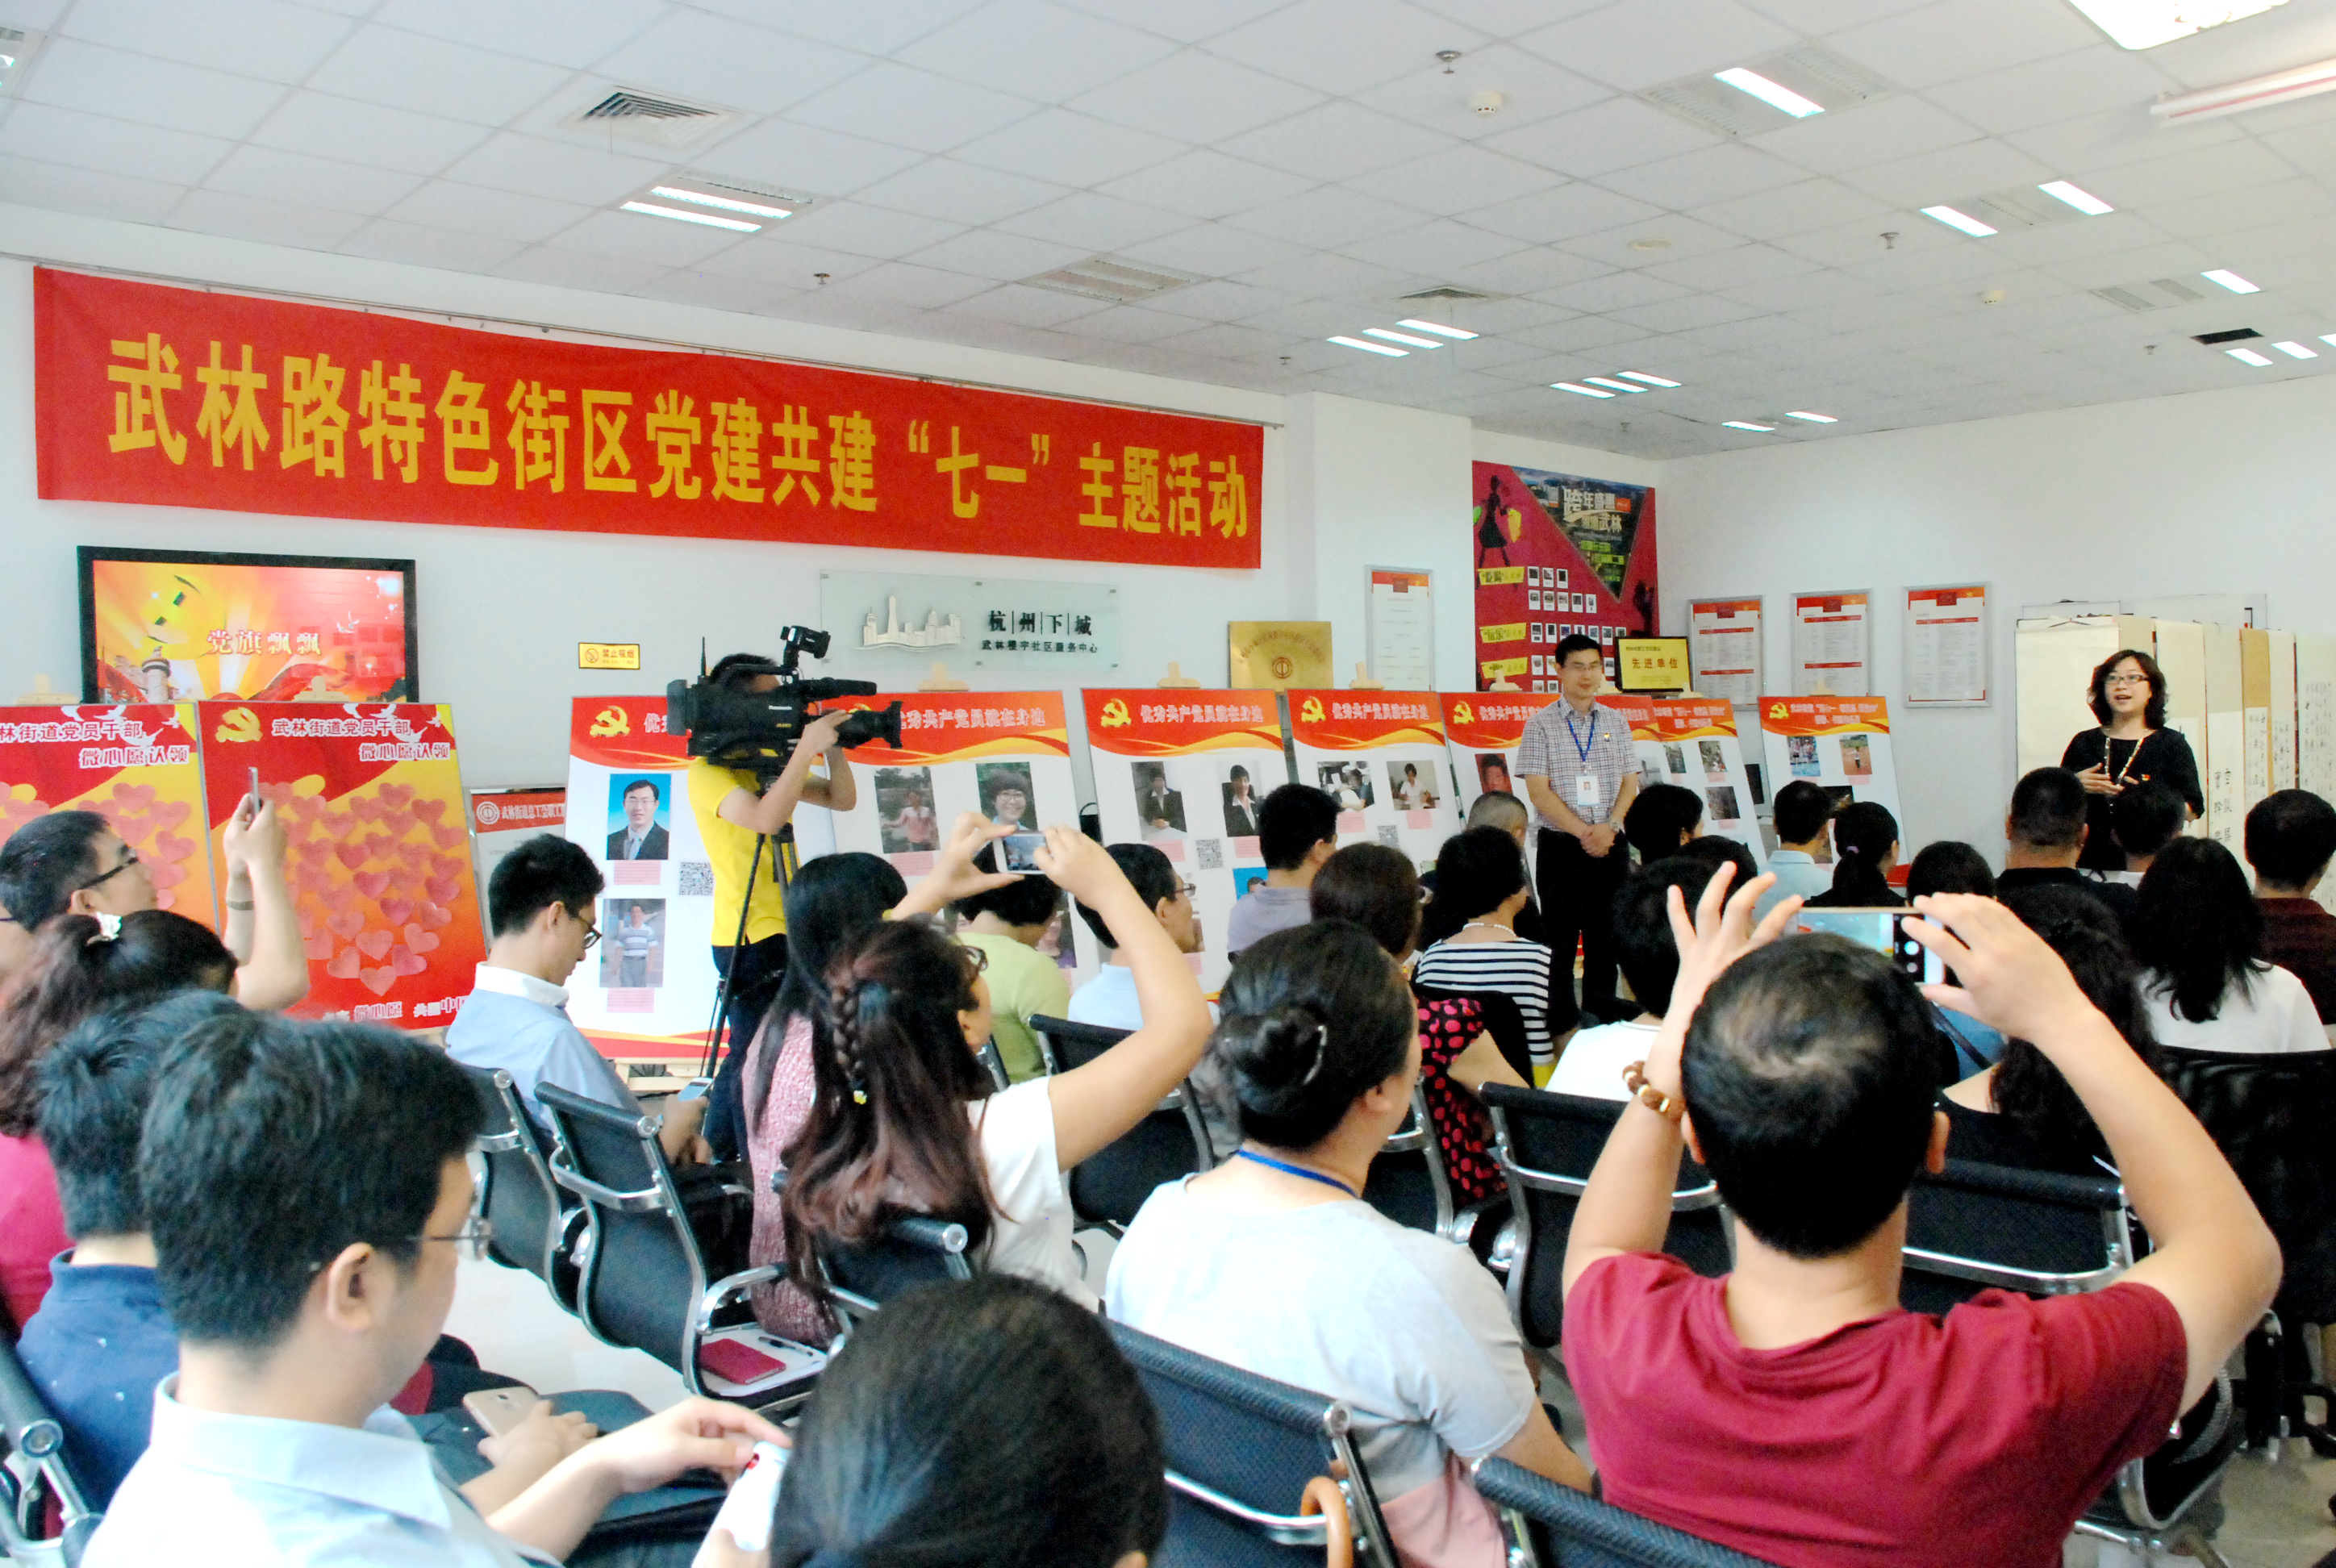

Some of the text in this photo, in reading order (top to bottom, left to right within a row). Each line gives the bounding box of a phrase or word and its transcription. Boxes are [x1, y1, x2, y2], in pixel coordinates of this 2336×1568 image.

[206, 629, 322, 655] 党旗飘飘
[982, 640, 1098, 653] 武林楼宇社区服务中心
[603, 648, 635, 659] 禁止吸烟
[1632, 657, 1678, 669] 先进单位
[1141, 704, 1264, 724] 优秀共产党员就在身边
[272, 719, 412, 737] 武林街道党员干部
[79, 745, 190, 769] 微心愿认领
[359, 742, 451, 761] 微心愿认领
